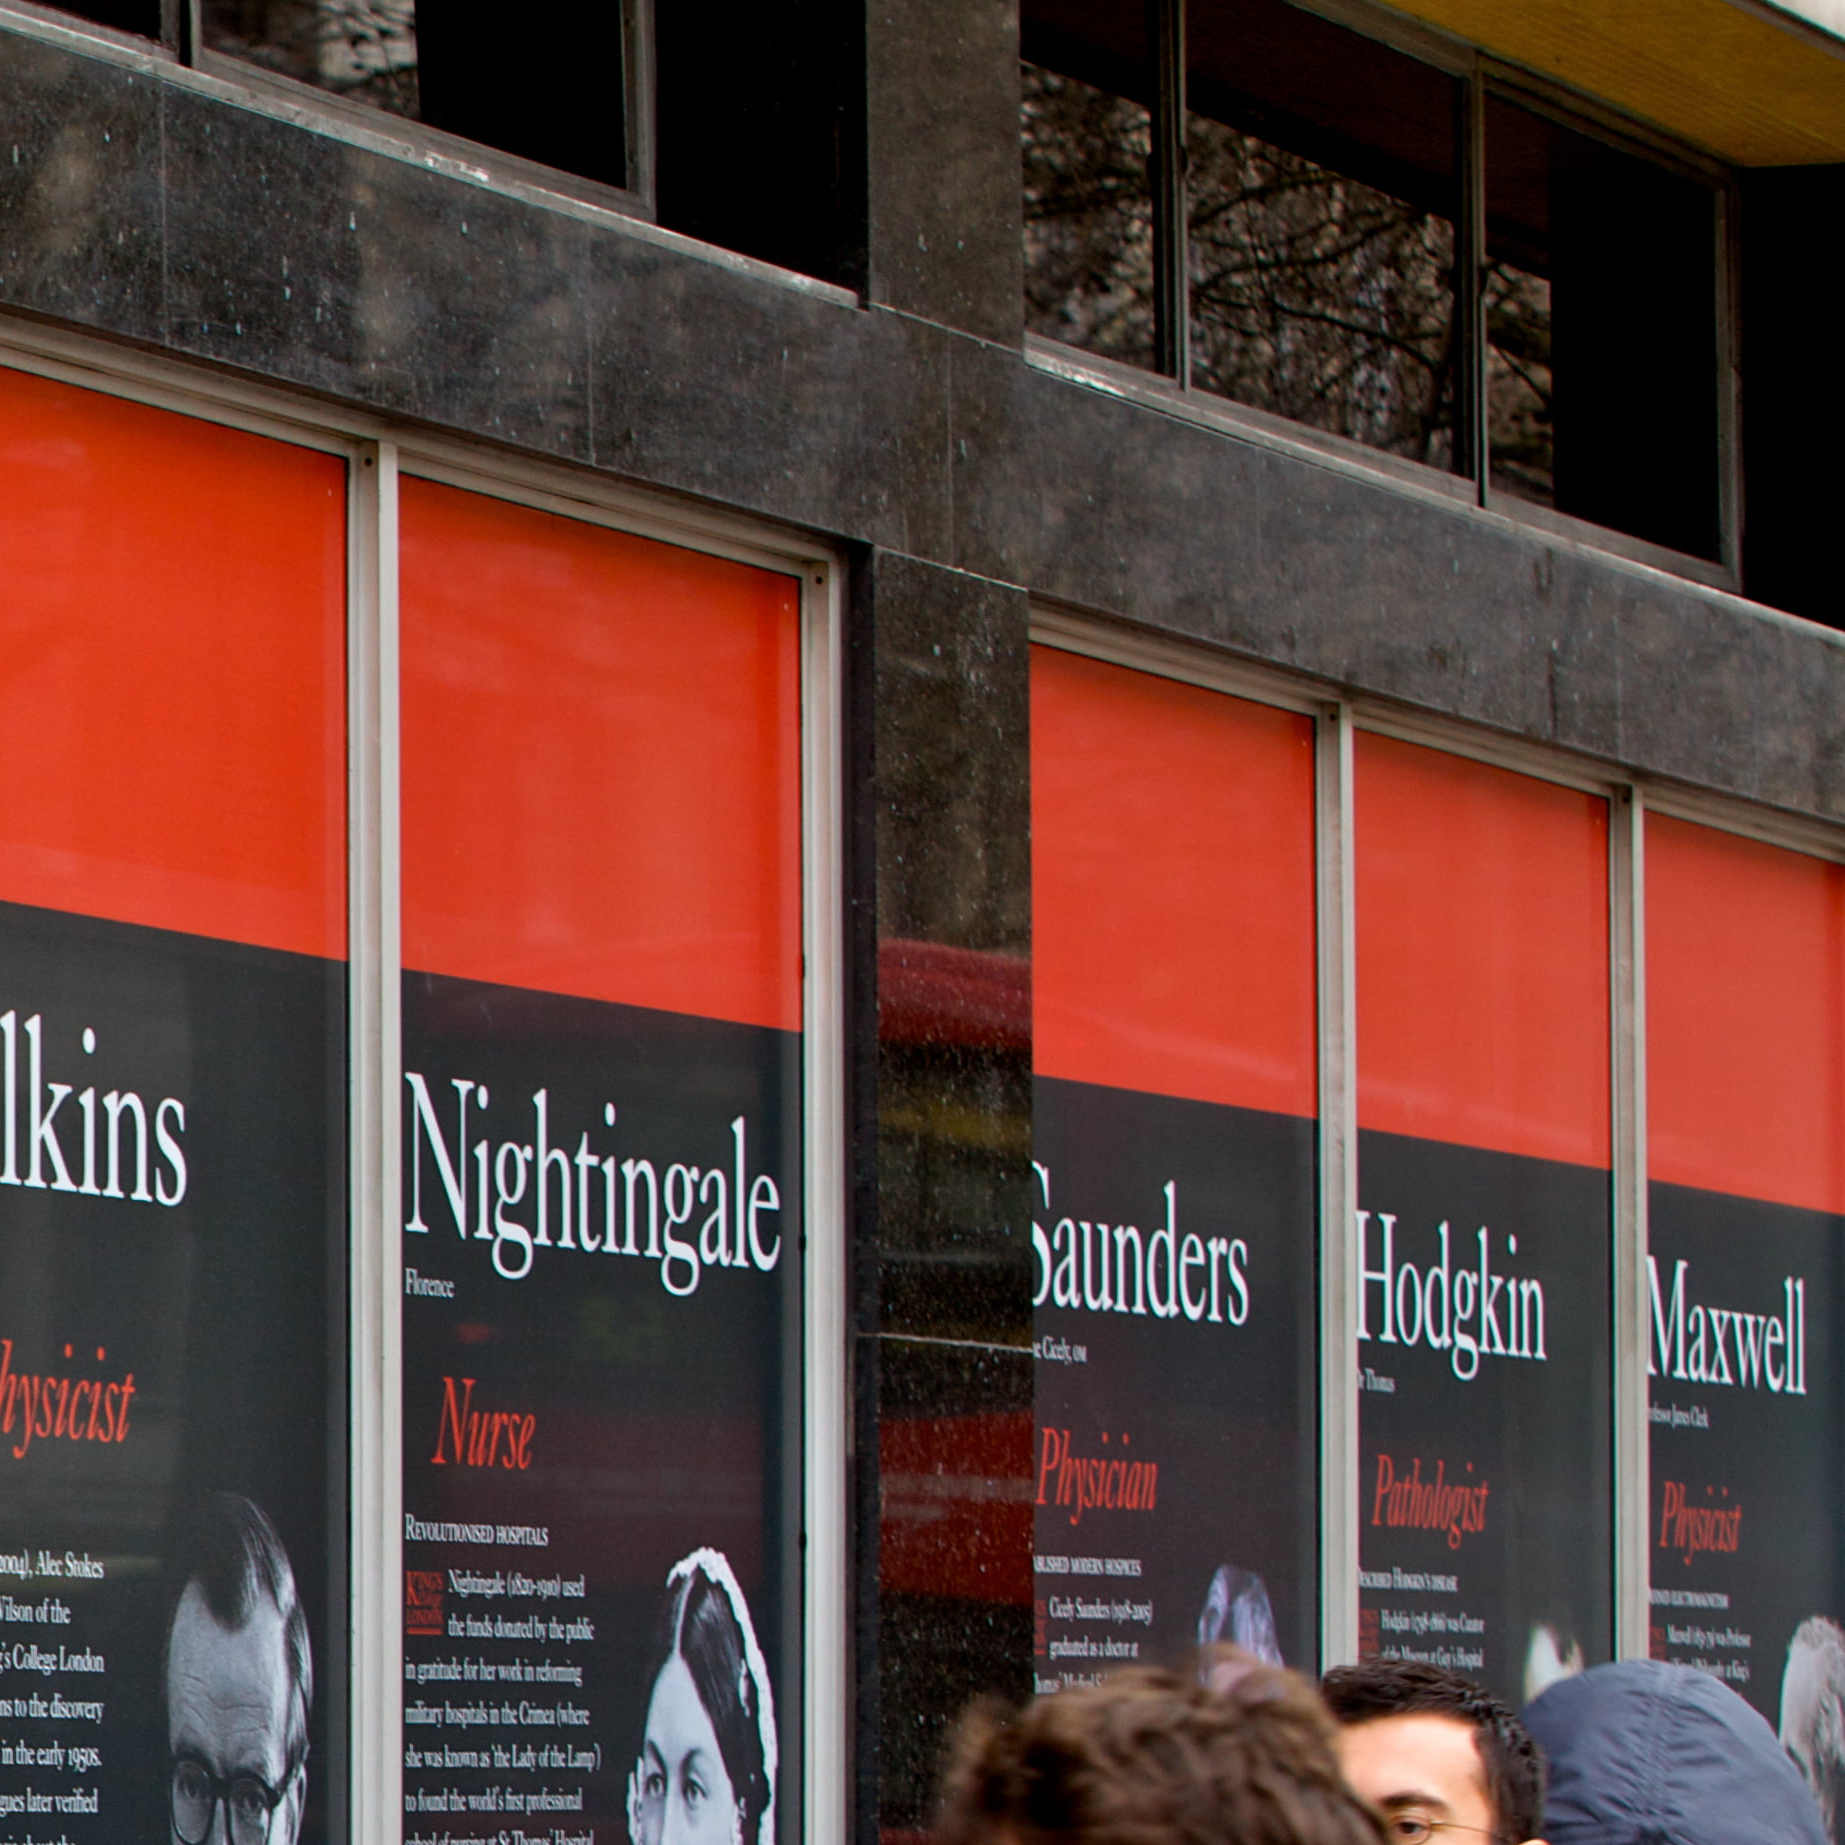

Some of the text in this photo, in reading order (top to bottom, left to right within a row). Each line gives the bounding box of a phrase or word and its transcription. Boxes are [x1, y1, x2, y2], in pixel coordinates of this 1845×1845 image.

[405, 1072, 780, 1295] Nightingale
[406, 1268, 454, 1297] Florence
[1358, 1210, 1546, 1381] Hodgkin
[1647, 1255, 1806, 1394] Maxwell
[431, 1376, 536, 1469] Nurse
[1034, 1427, 1158, 1525] Physician
[1372, 1454, 1490, 1549] Pathologist
[1660, 1480, 1742, 1565] Physicist
